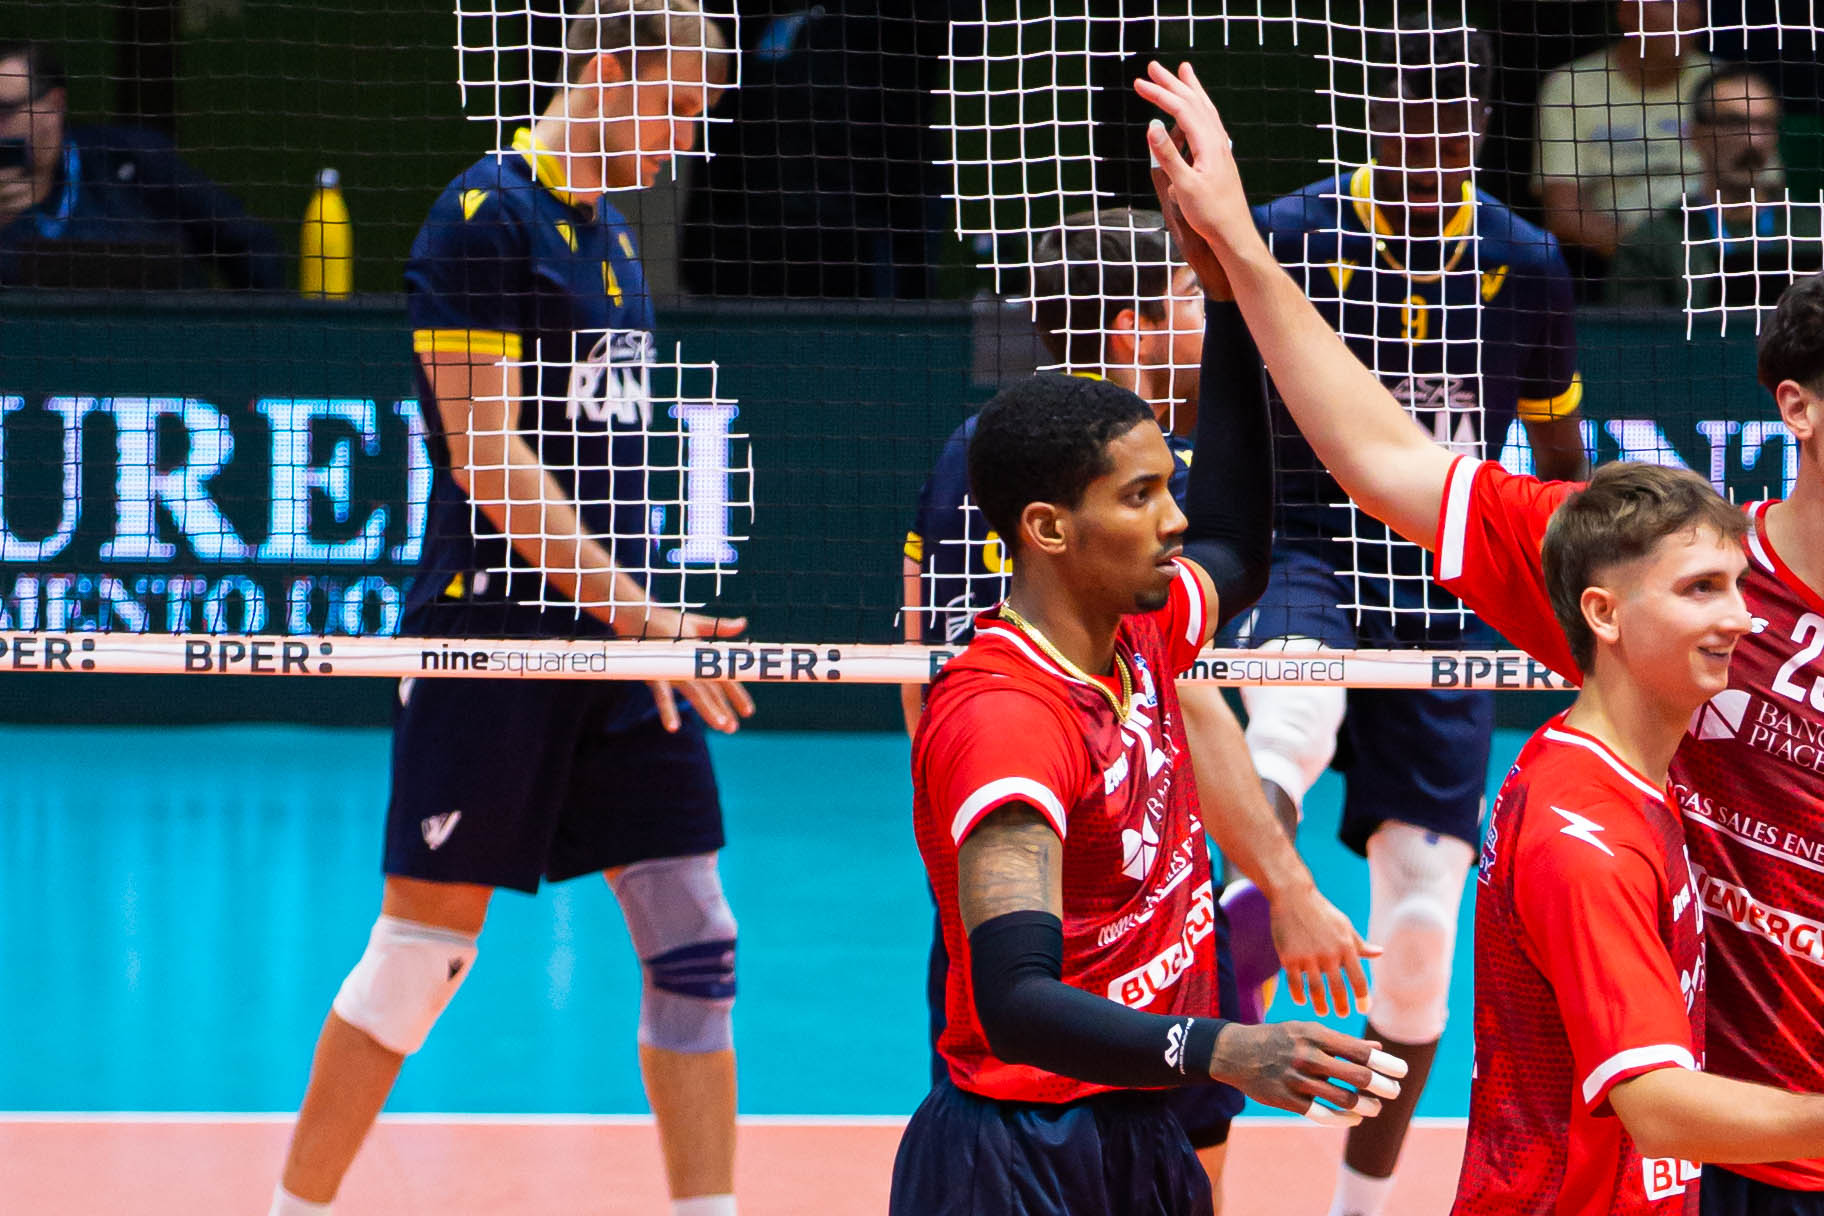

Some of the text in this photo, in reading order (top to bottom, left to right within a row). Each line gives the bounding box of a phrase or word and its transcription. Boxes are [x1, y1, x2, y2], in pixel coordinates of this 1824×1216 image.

[1400, 293, 1430, 347] 9
[420, 645, 607, 677] ninesquared
[1176, 655, 1345, 686] nesquared
[1672, 783, 1714, 816] GAS
[1717, 806, 1780, 845] SALES
